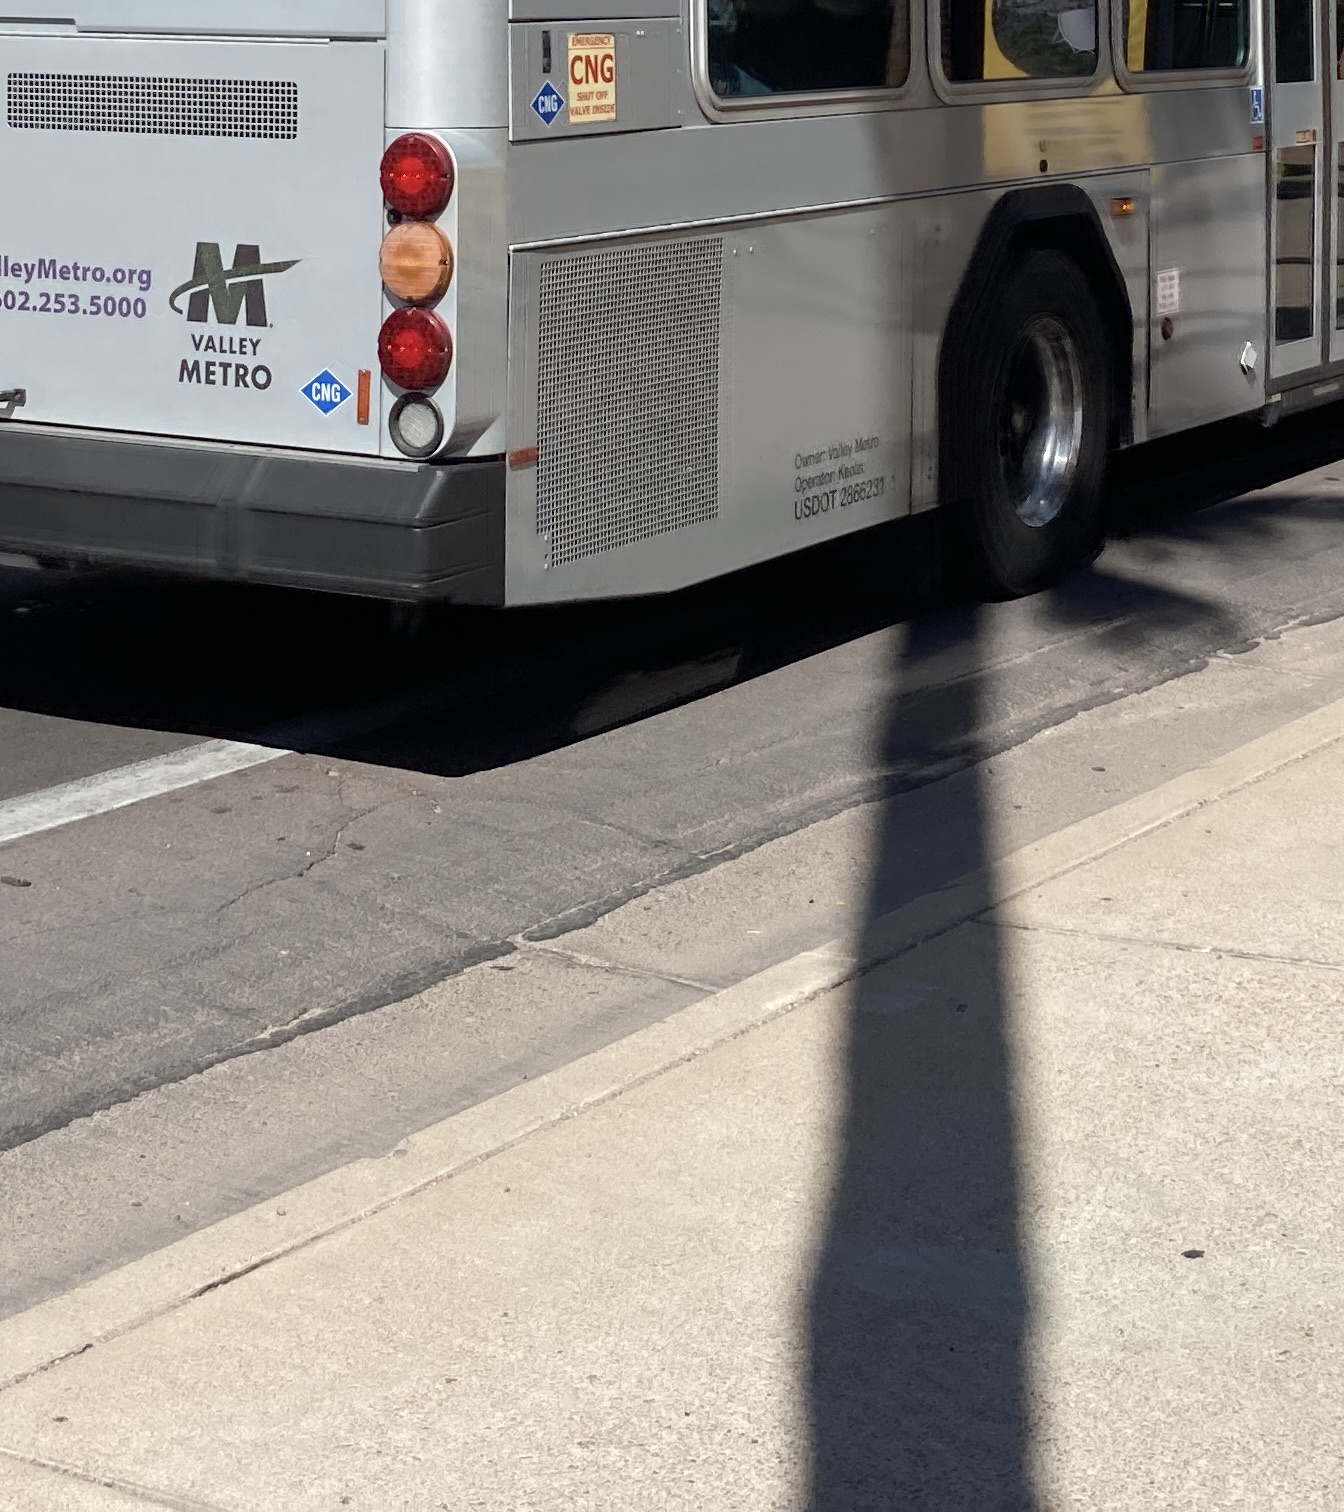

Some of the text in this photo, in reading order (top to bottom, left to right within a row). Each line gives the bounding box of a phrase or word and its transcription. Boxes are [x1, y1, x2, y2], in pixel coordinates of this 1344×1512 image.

[570, 54, 614, 85] CNG
[538, 94, 558, 114] CNG
[577, 90, 608, 101] SHUT OFF
[190, 333, 262, 356] VALLEY
[178, 359, 273, 390] METRO
[311, 382, 341, 402] CNG
[794, 490, 837, 520] USDOT
